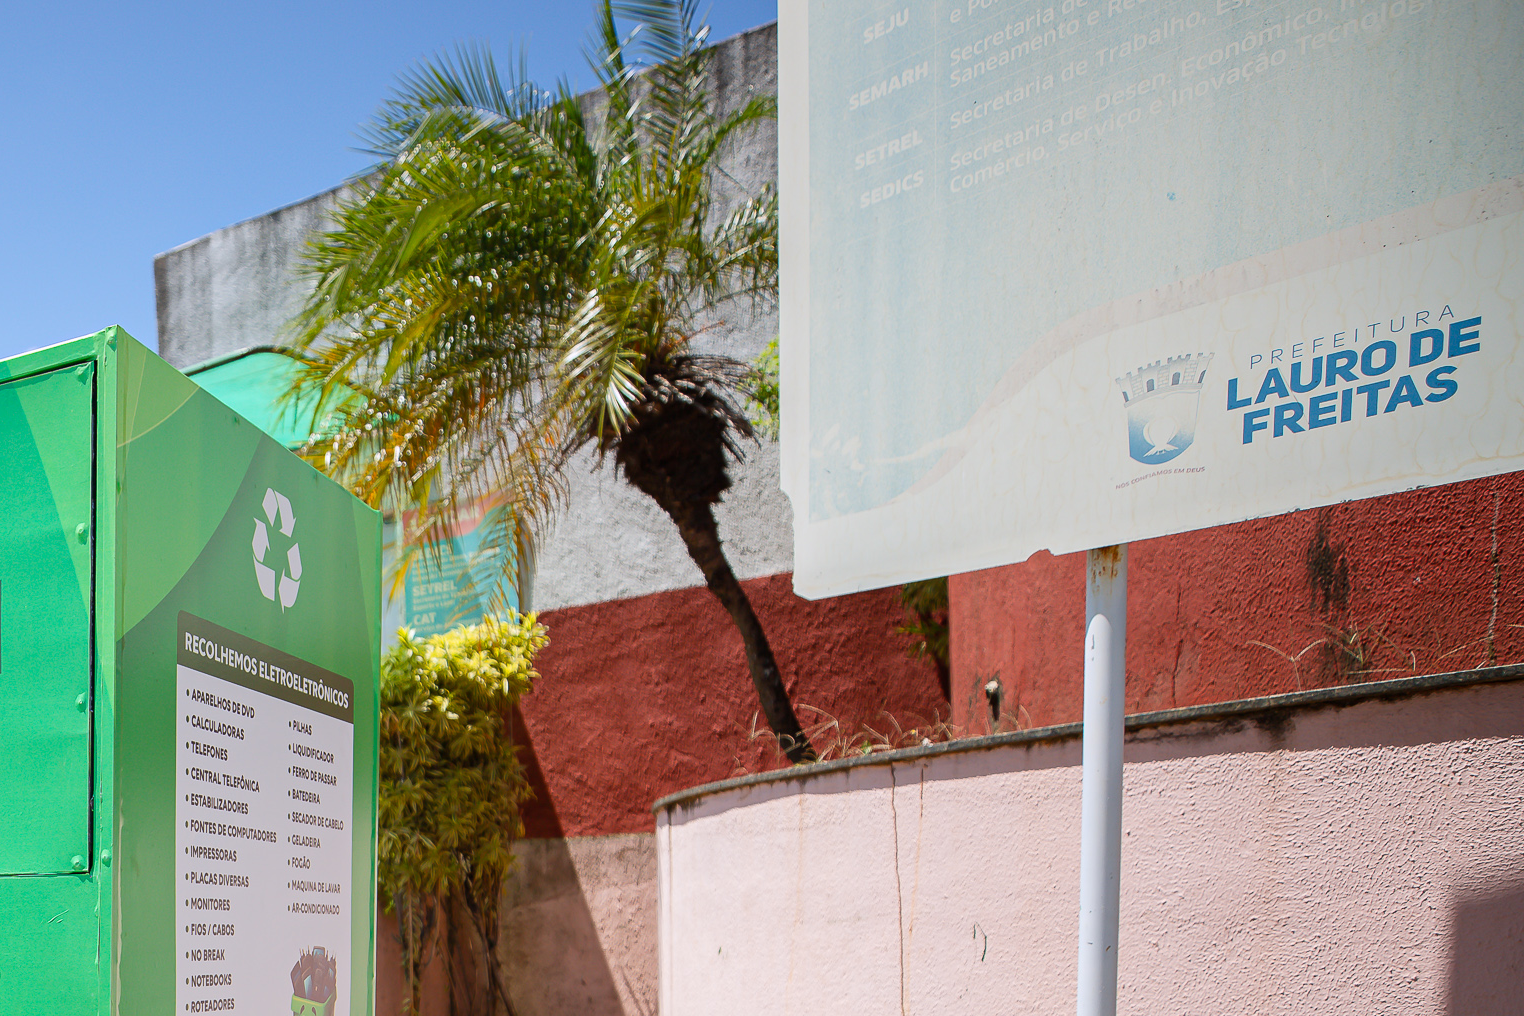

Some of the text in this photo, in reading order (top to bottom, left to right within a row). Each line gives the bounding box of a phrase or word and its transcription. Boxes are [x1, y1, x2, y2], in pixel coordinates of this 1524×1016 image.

[863, 8, 909, 44] SEJU
[950, 8, 961, 24] e
[949, 5, 1054, 67] Secretaria
[949, 19, 1080, 88] Saneamento
[1086, 10, 1100, 26] e
[849, 61, 928, 111] SEMARH
[854, 130, 923, 171] SETREL
[949, 72, 1054, 130] Secretaria
[1060, 59, 1088, 84] de
[1095, 10, 1208, 68] Trabalho,
[949, 6, 1330, 171] Secretaria de Desen. Econômico,
[860, 169, 924, 209] SEDICS
[1057, 108, 1141, 154] Serviço
[1149, 99, 1162, 116] e
[1170, 44, 1287, 110] Inovação
[1250, 304, 1455, 369] PREFEITURA
[1227, 316, 1482, 411] LAURO DE
[1242, 365, 1459, 445] FREITAS
[1131, 468, 1173, 485] CONFIAMOS
[1185, 466, 1206, 474] DEUS
[413, 612, 436, 625] CAT
[184, 631, 349, 709] RECOLHEMOS ELETROELETRÔNICOS
[191, 688, 255, 718] APARELHOS DE DVD
[191, 715, 245, 740] CALCULADORAS
[292, 720, 313, 736] PILHAS
[191, 741, 228, 761] TELEFONES
[292, 743, 334, 764] LIQUIDIFICADOR
[191, 767, 260, 793] CENTRAL TELEFÔNICA
[292, 766, 337, 786] FERRO DE PASSAR
[190, 793, 249, 814] ESTABILIZADORES
[292, 789, 320, 805] BATEDEIRA
[190, 819, 277, 843] FONTES DE COMPUTADORES
[291, 812, 344, 831] SECADOR DE CABELO
[291, 834, 321, 849] GELADEIRA
[190, 845, 237, 862] IMPRESSORAS
[291, 856, 311, 870] FOGÃO
[190, 871, 249, 888] PLACAS DIVERSAS
[317, 882, 324, 893] DE
[325, 882, 341, 894] LAVAR
[190, 897, 231, 911] MONITORES
[291, 902, 340, 915] AR-CONDICIONADO
[190, 923, 207, 935] FIOS
[212, 923, 235, 936] CABOS
[191, 949, 225, 961] NO BREAK
[191, 973, 232, 987] NOTEBOOKS
[190, 998, 235, 1013] ROTEADORES
